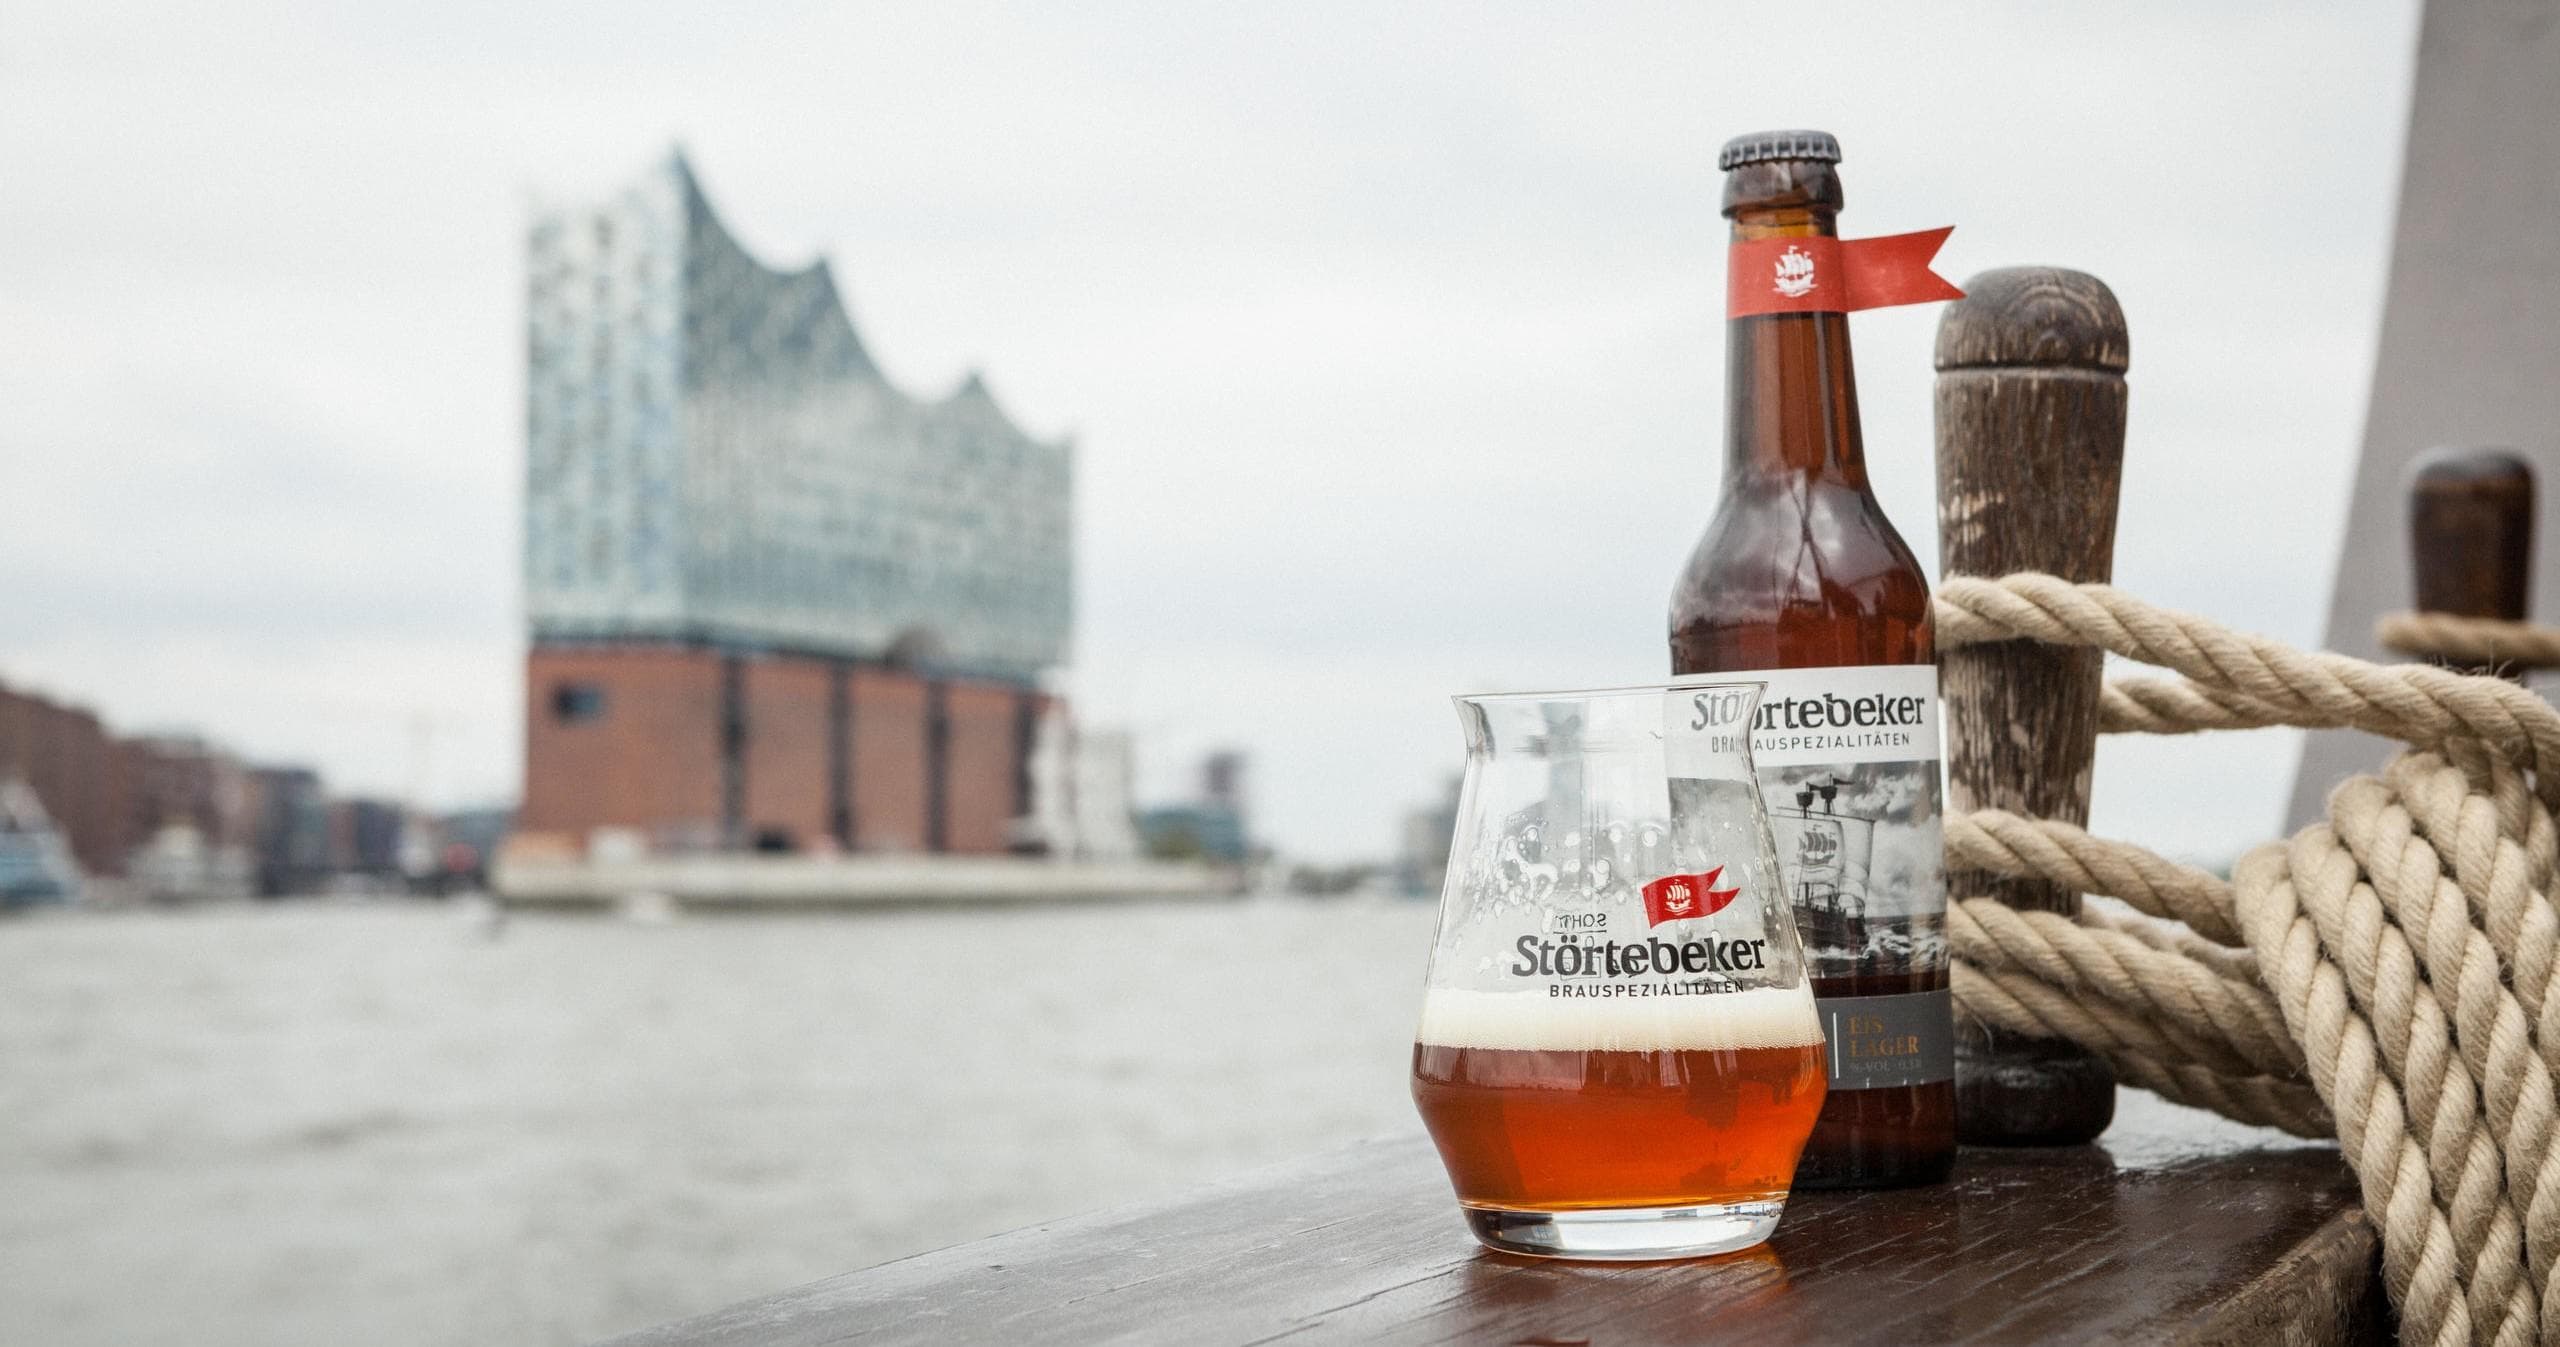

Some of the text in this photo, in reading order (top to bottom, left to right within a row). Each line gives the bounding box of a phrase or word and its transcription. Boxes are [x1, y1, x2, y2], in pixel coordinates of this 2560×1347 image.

[1511, 935, 1766, 977] Störtebeker
[1550, 980, 1745, 998] BRAUSPEZIALITÄTEN
[1848, 1035, 1920, 1057] LAGER
